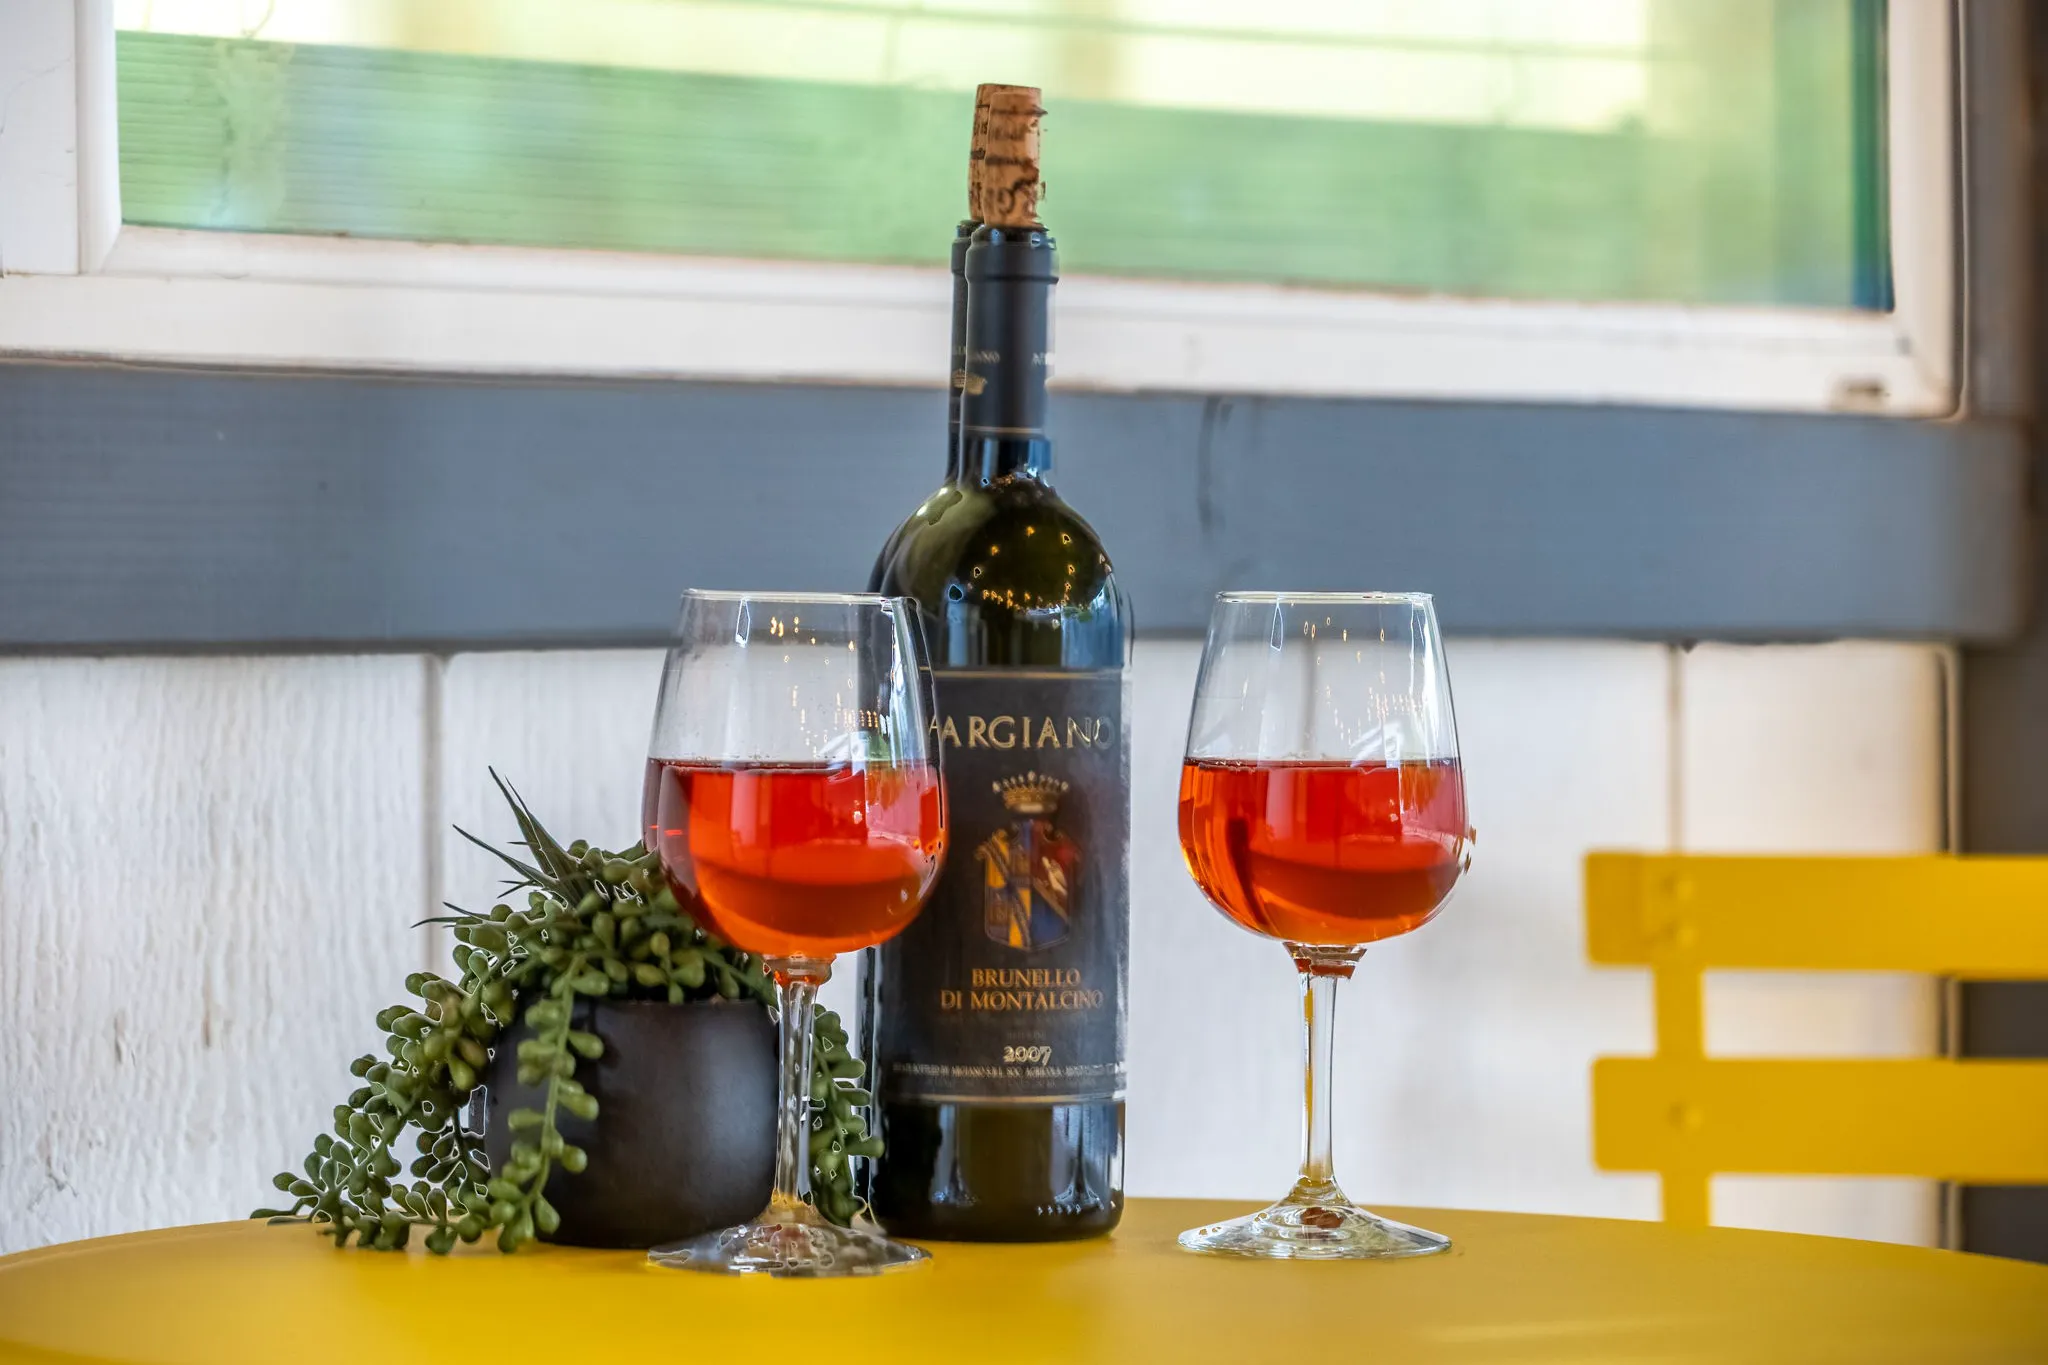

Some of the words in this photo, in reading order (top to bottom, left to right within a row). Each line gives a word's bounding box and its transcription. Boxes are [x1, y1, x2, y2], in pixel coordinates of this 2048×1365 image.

[938, 714, 1116, 749] ARGIANO
[971, 967, 1082, 988] BRUNELLO
[940, 989, 963, 1010] DI
[970, 990, 1104, 1011] MONTALCINO
[1003, 1045, 1052, 1066] 2007
